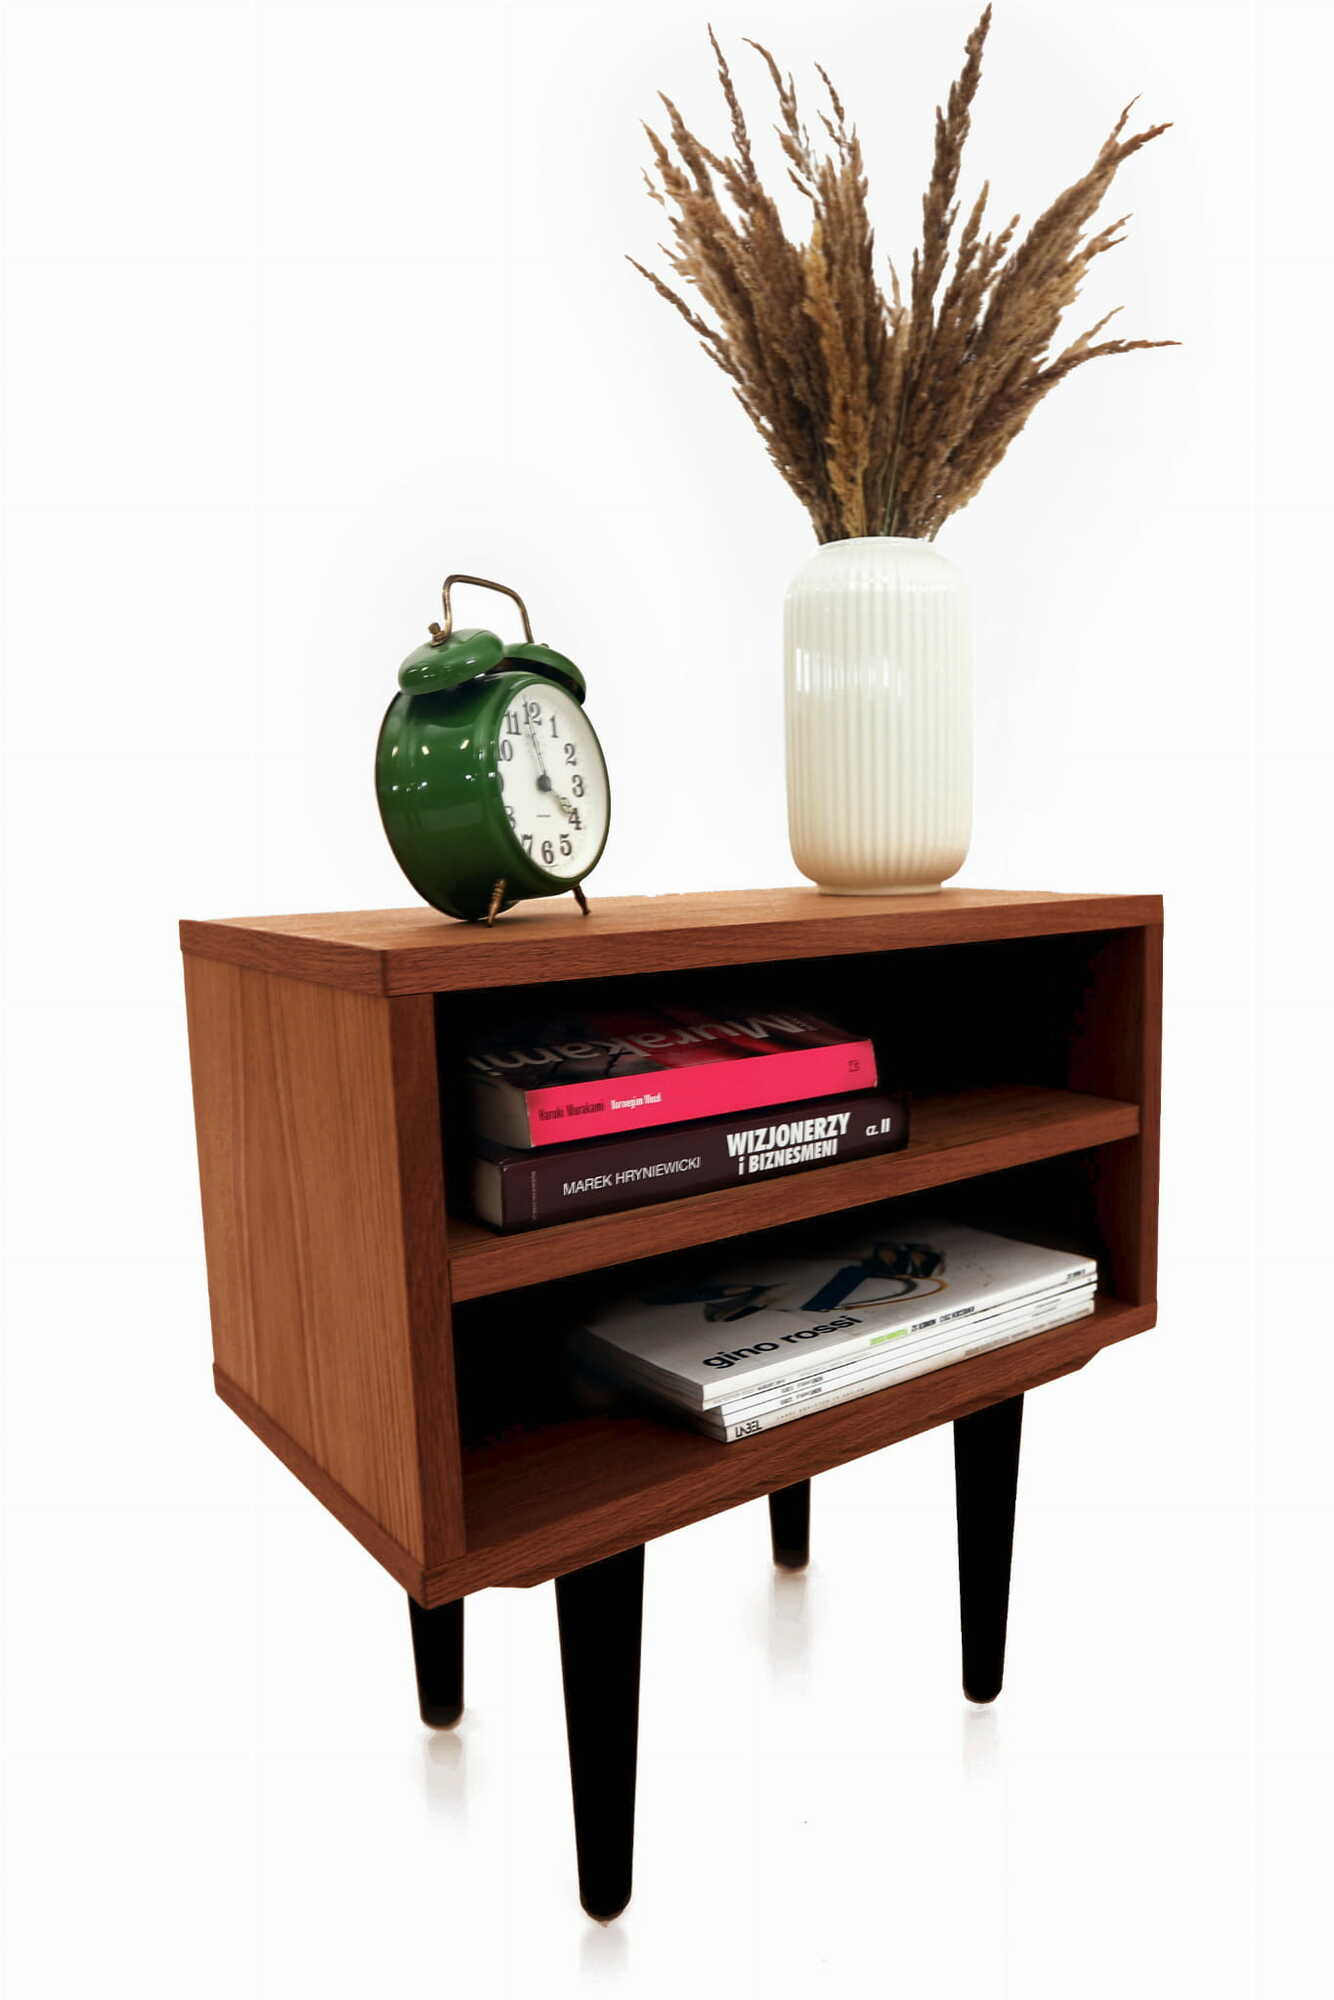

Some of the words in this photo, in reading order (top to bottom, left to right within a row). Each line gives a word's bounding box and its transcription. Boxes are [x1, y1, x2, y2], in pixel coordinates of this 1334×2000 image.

[504, 712, 522, 735] 11
[522, 700, 542, 726] 12
[549, 716, 559, 738] 1
[564, 743, 577, 766] 2
[572, 775, 585, 798] 3
[568, 808, 582, 830] 4
[521, 834, 534, 857] 7
[541, 841, 554, 864] 6
[560, 834, 573, 856] 5
[464, 1013, 805, 1077] Murakami
[726, 1112, 851, 1157] WIZJONERZY
[738, 1156, 744, 1175] i
[748, 1138, 838, 1174] BIZNESMENI
[563, 1173, 613, 1196] MAREK
[615, 1156, 701, 1185] HRYNIEWICKI
[703, 1342, 780, 1369] gino
[780, 1315, 864, 1343] rossi
